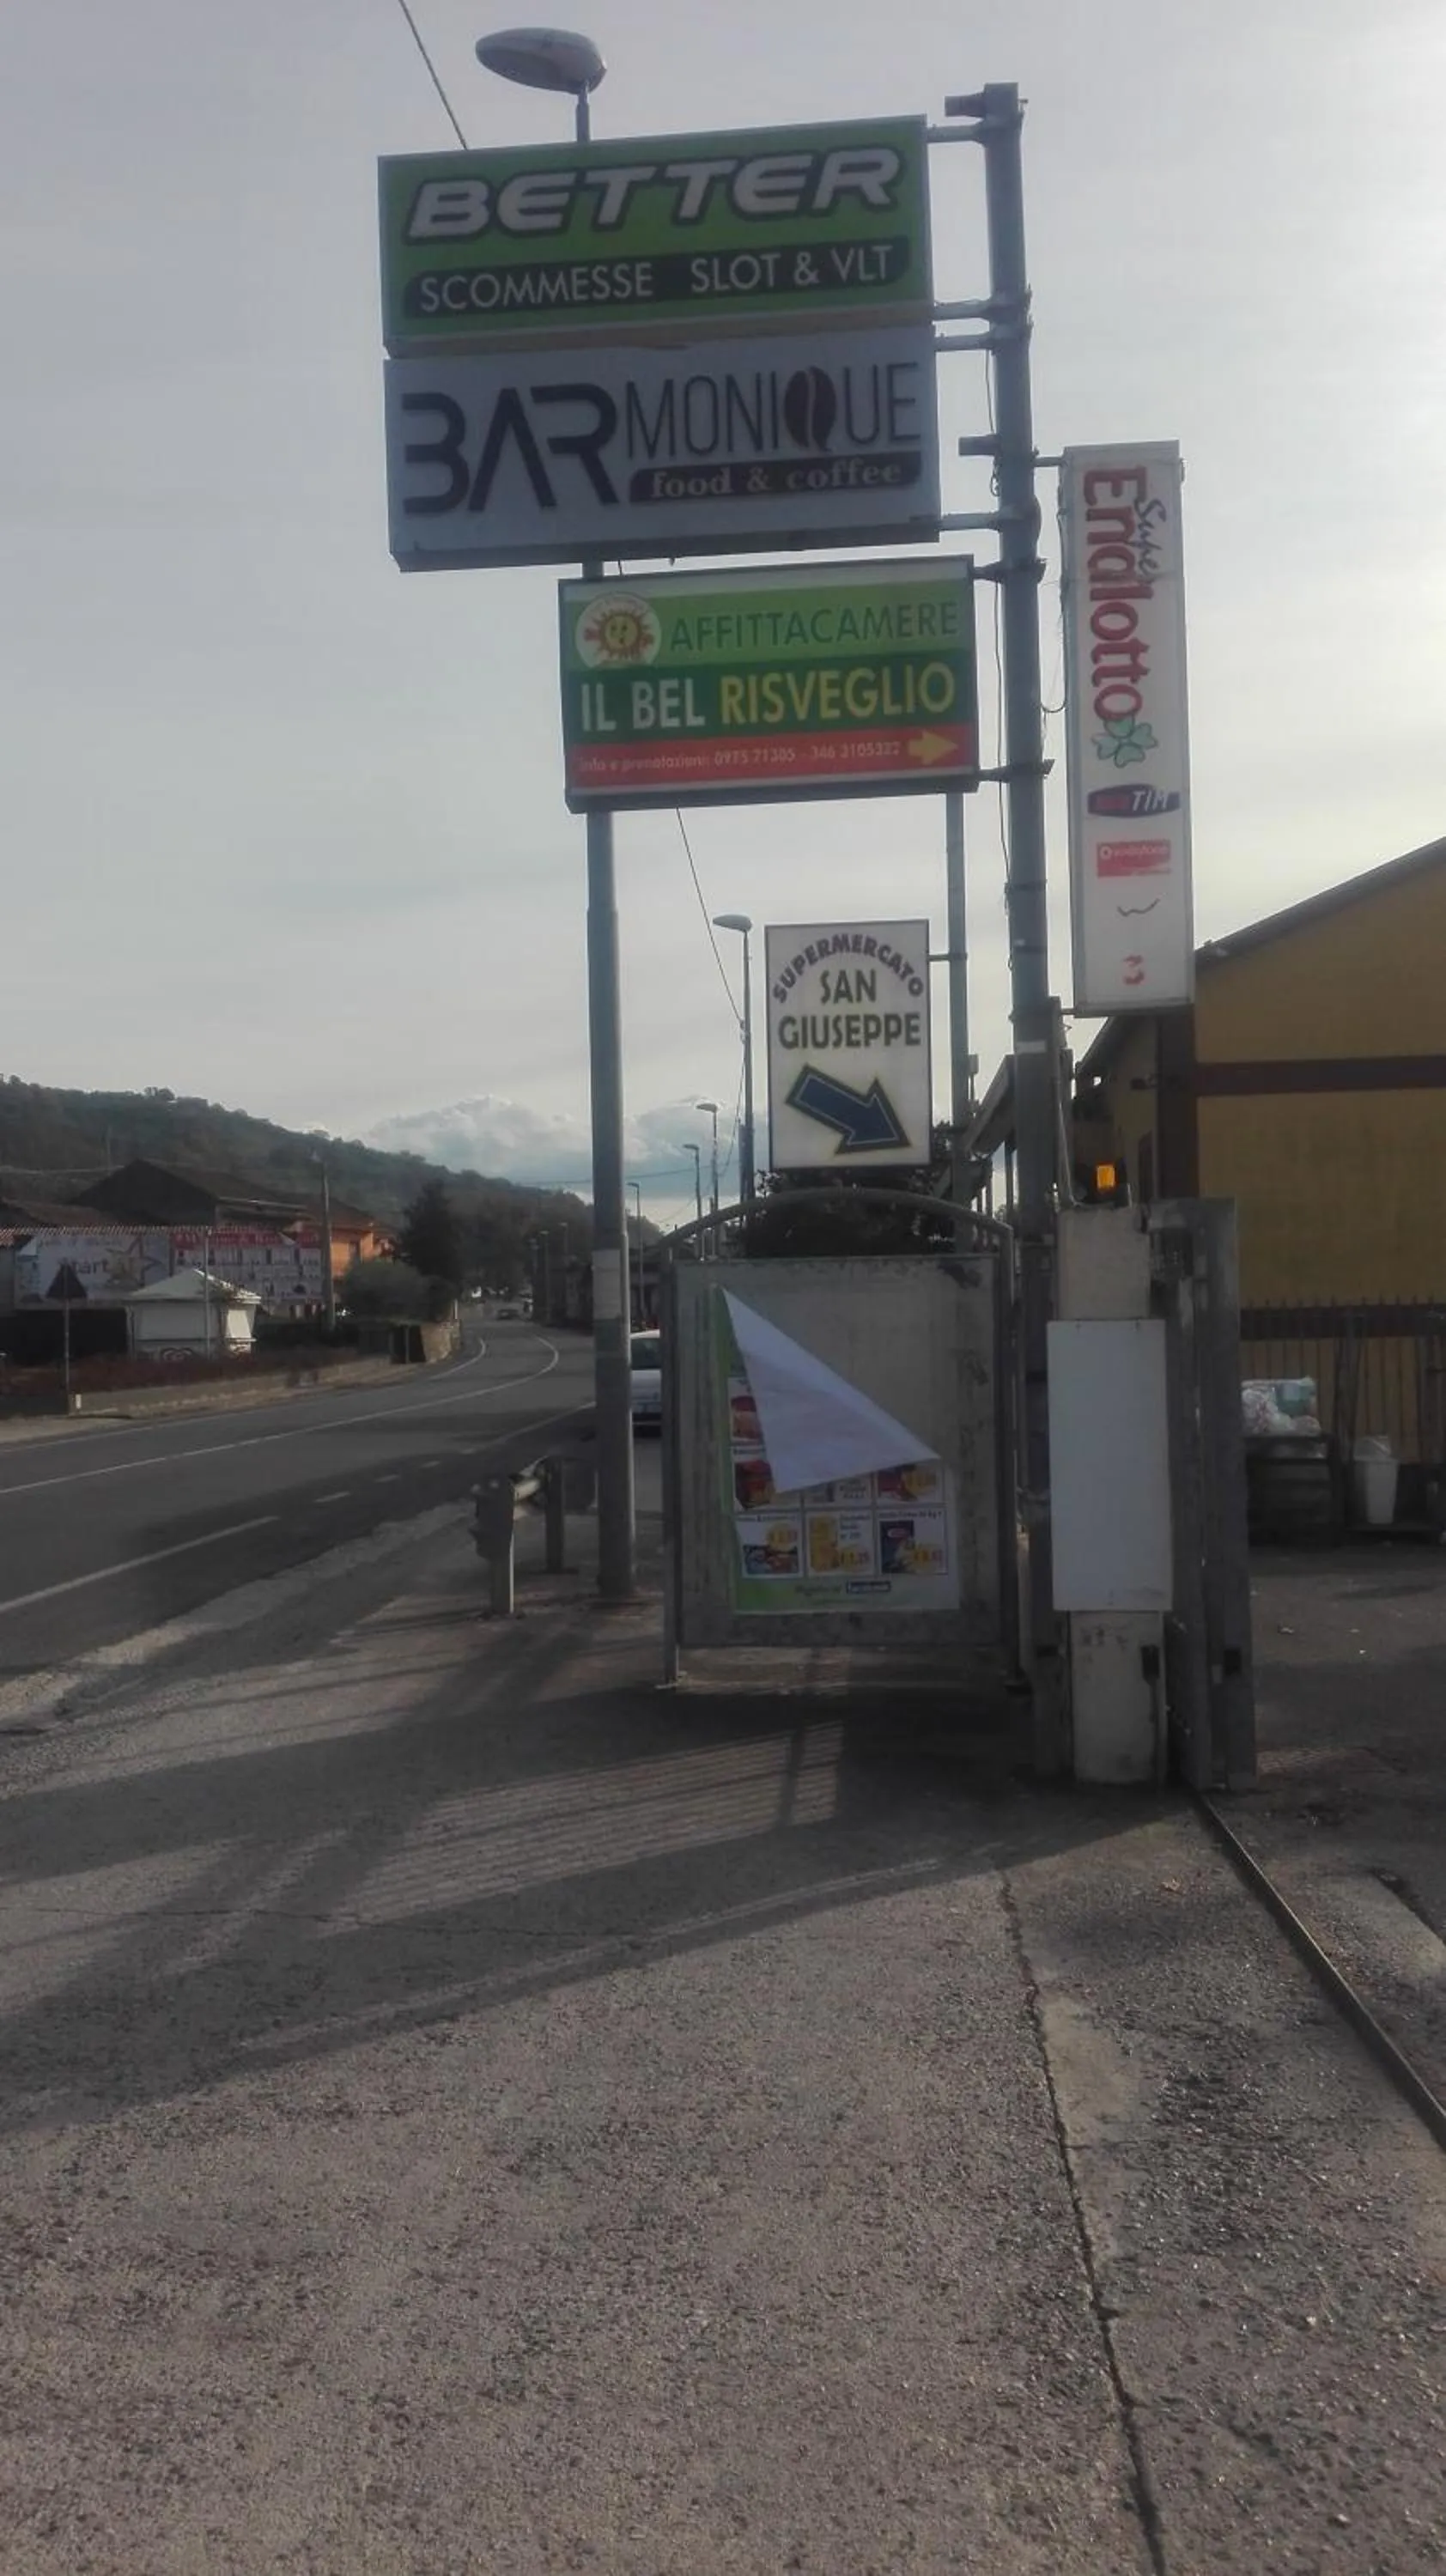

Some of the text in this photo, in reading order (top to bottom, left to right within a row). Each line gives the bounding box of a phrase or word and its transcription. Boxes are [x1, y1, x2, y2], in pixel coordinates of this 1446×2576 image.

[407, 146, 902, 239] BETTER
[420, 245, 893, 314] SCOMMESSE SLOT & VLT
[626, 361, 923, 460] MONIQUE
[401, 382, 621, 516] BAR
[649, 457, 902, 500] food & coffee
[670, 600, 959, 653] AFFITTACAMERE
[1083, 465, 1155, 722] Enalotto
[580, 660, 957, 732] IL BEL RISVEGLIO
[1132, 789, 1170, 811] TIM
[773, 933, 925, 1004] SUPERMERCATO
[820, 969, 878, 1005] SAN
[778, 1012, 921, 1050] GIUSEPPE
